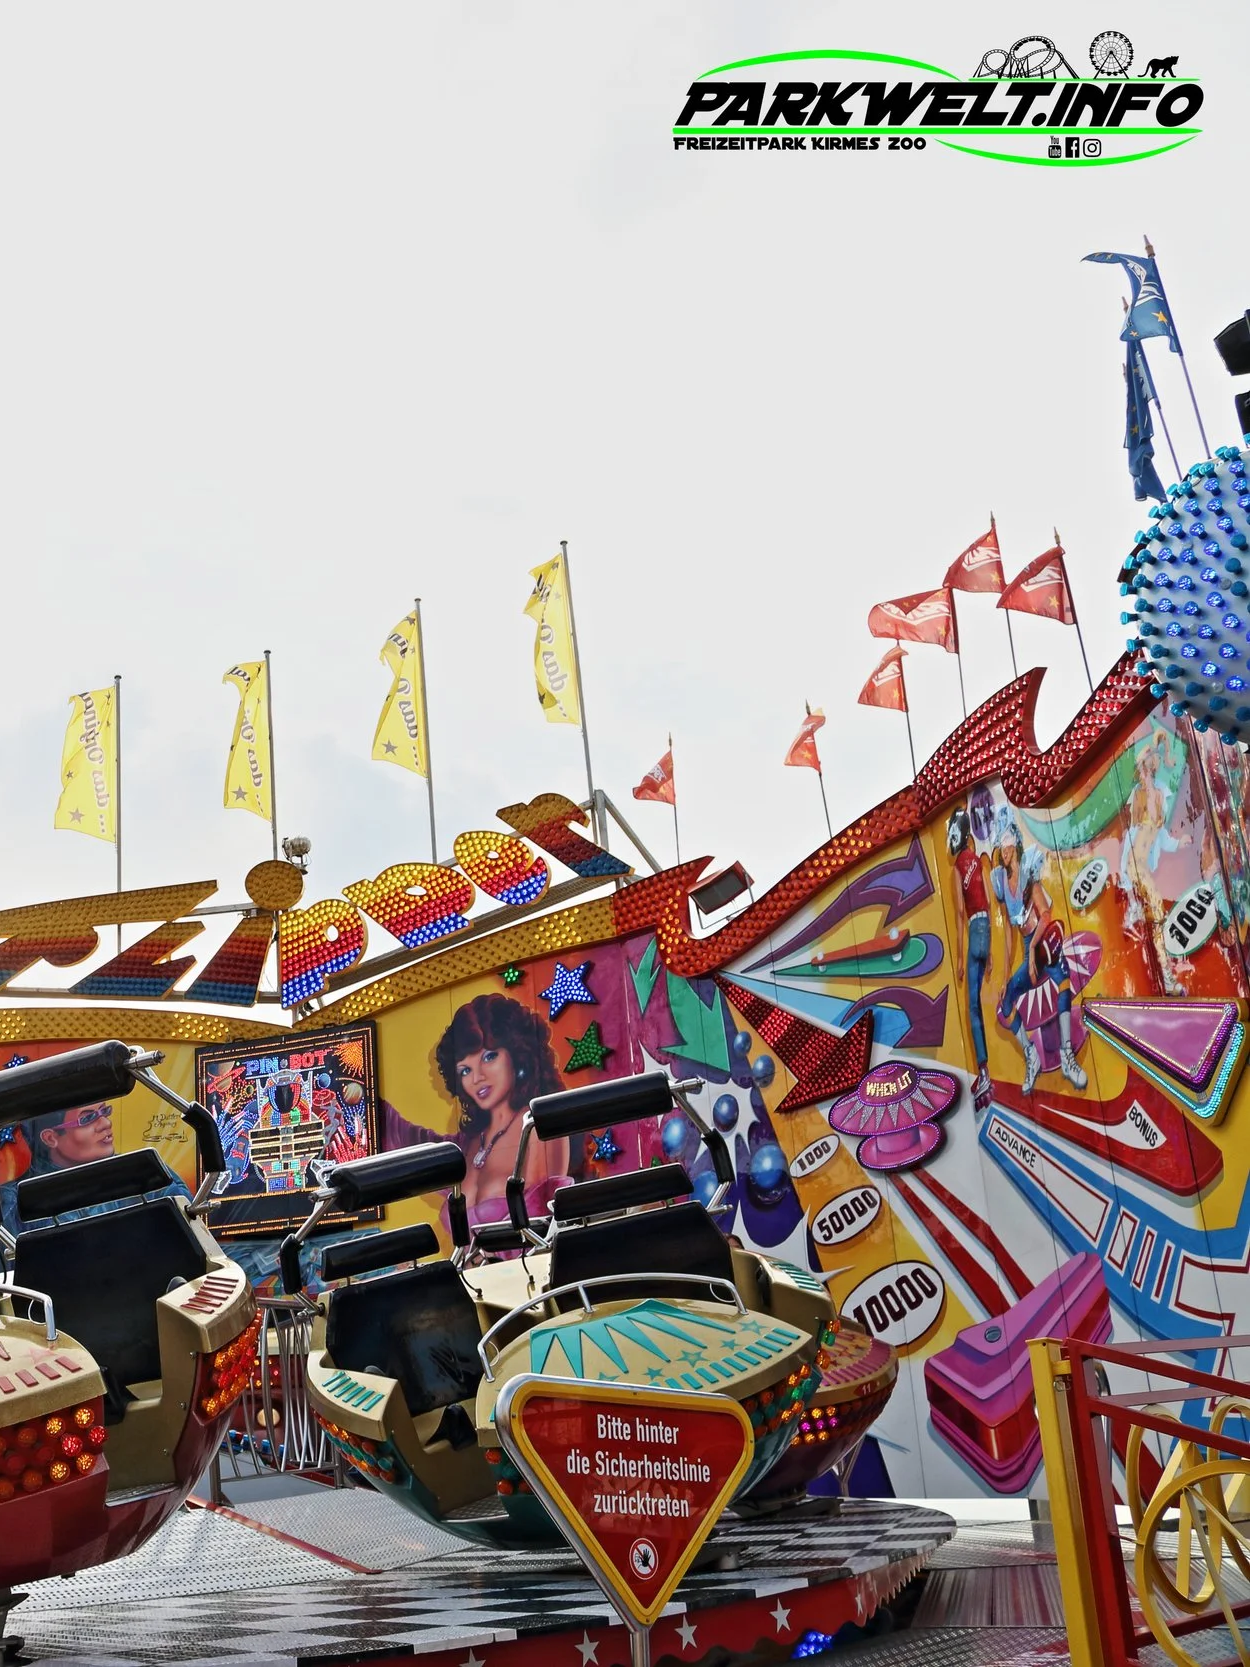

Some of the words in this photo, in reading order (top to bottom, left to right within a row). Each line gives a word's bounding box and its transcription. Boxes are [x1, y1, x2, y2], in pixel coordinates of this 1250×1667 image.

[243, 1057, 280, 1075] PIN
[289, 1049, 329, 1070] BOT
[865, 1081, 897, 1099] WHEN
[1128, 1106, 1159, 1148] BONUS
[796, 1140, 832, 1172] 1000
[994, 1126, 1037, 1169] ADVANCE
[817, 1189, 878, 1243] 50000
[852, 1267, 938, 1338] 10000
[862, 1383, 871, 1396] 11
[597, 1413, 631, 1441] Bitte
[636, 1417, 679, 1445] hinter
[566, 1449, 590, 1475] die
[595, 1450, 711, 1483] Sicherheitslinie
[594, 1490, 690, 1518] zurücktreten
